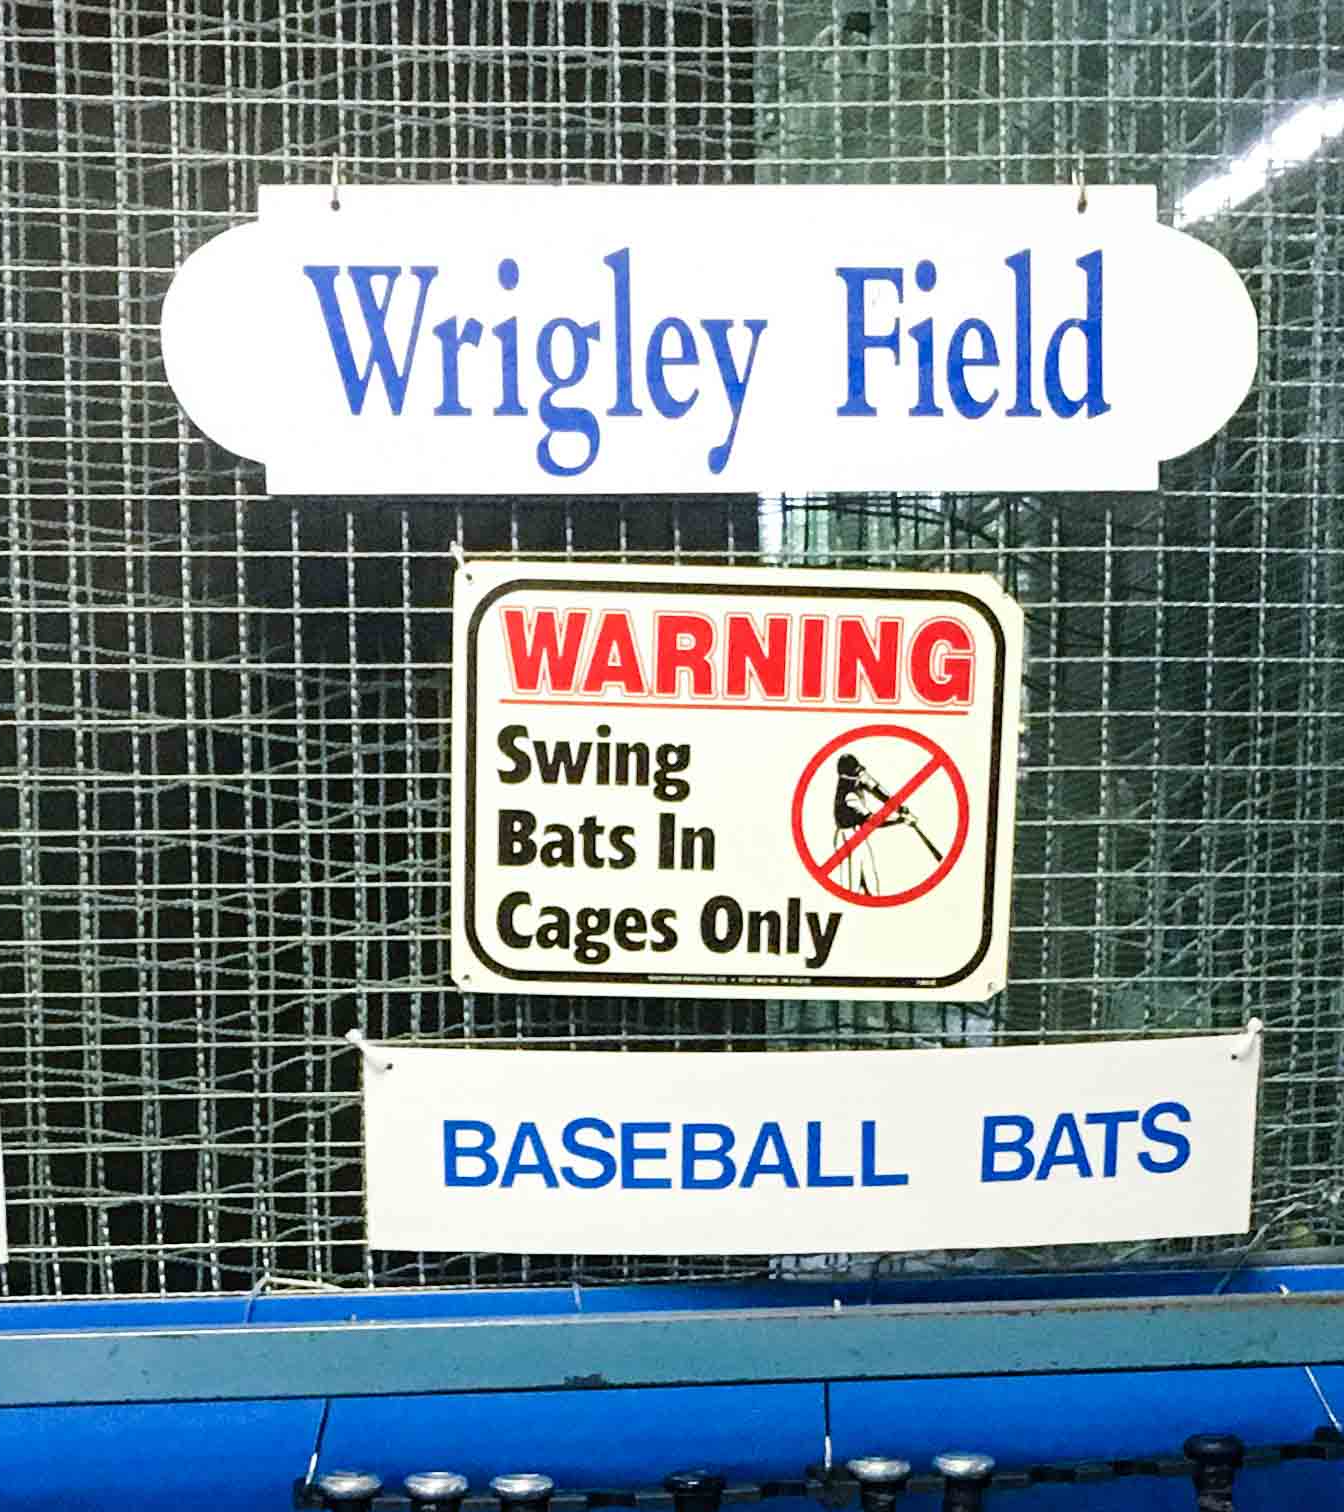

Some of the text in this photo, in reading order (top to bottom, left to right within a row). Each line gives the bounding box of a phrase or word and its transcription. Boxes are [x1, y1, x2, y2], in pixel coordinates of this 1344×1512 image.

[303, 248, 1112, 476] Wrigley Field
[500, 606, 975, 706] WARNING
[497, 724, 691, 801] Swing
[497, 809, 715, 870] Bats In
[496, 891, 842, 967] Cages Only
[442, 1101, 1192, 1189] BASEBALL BATS
